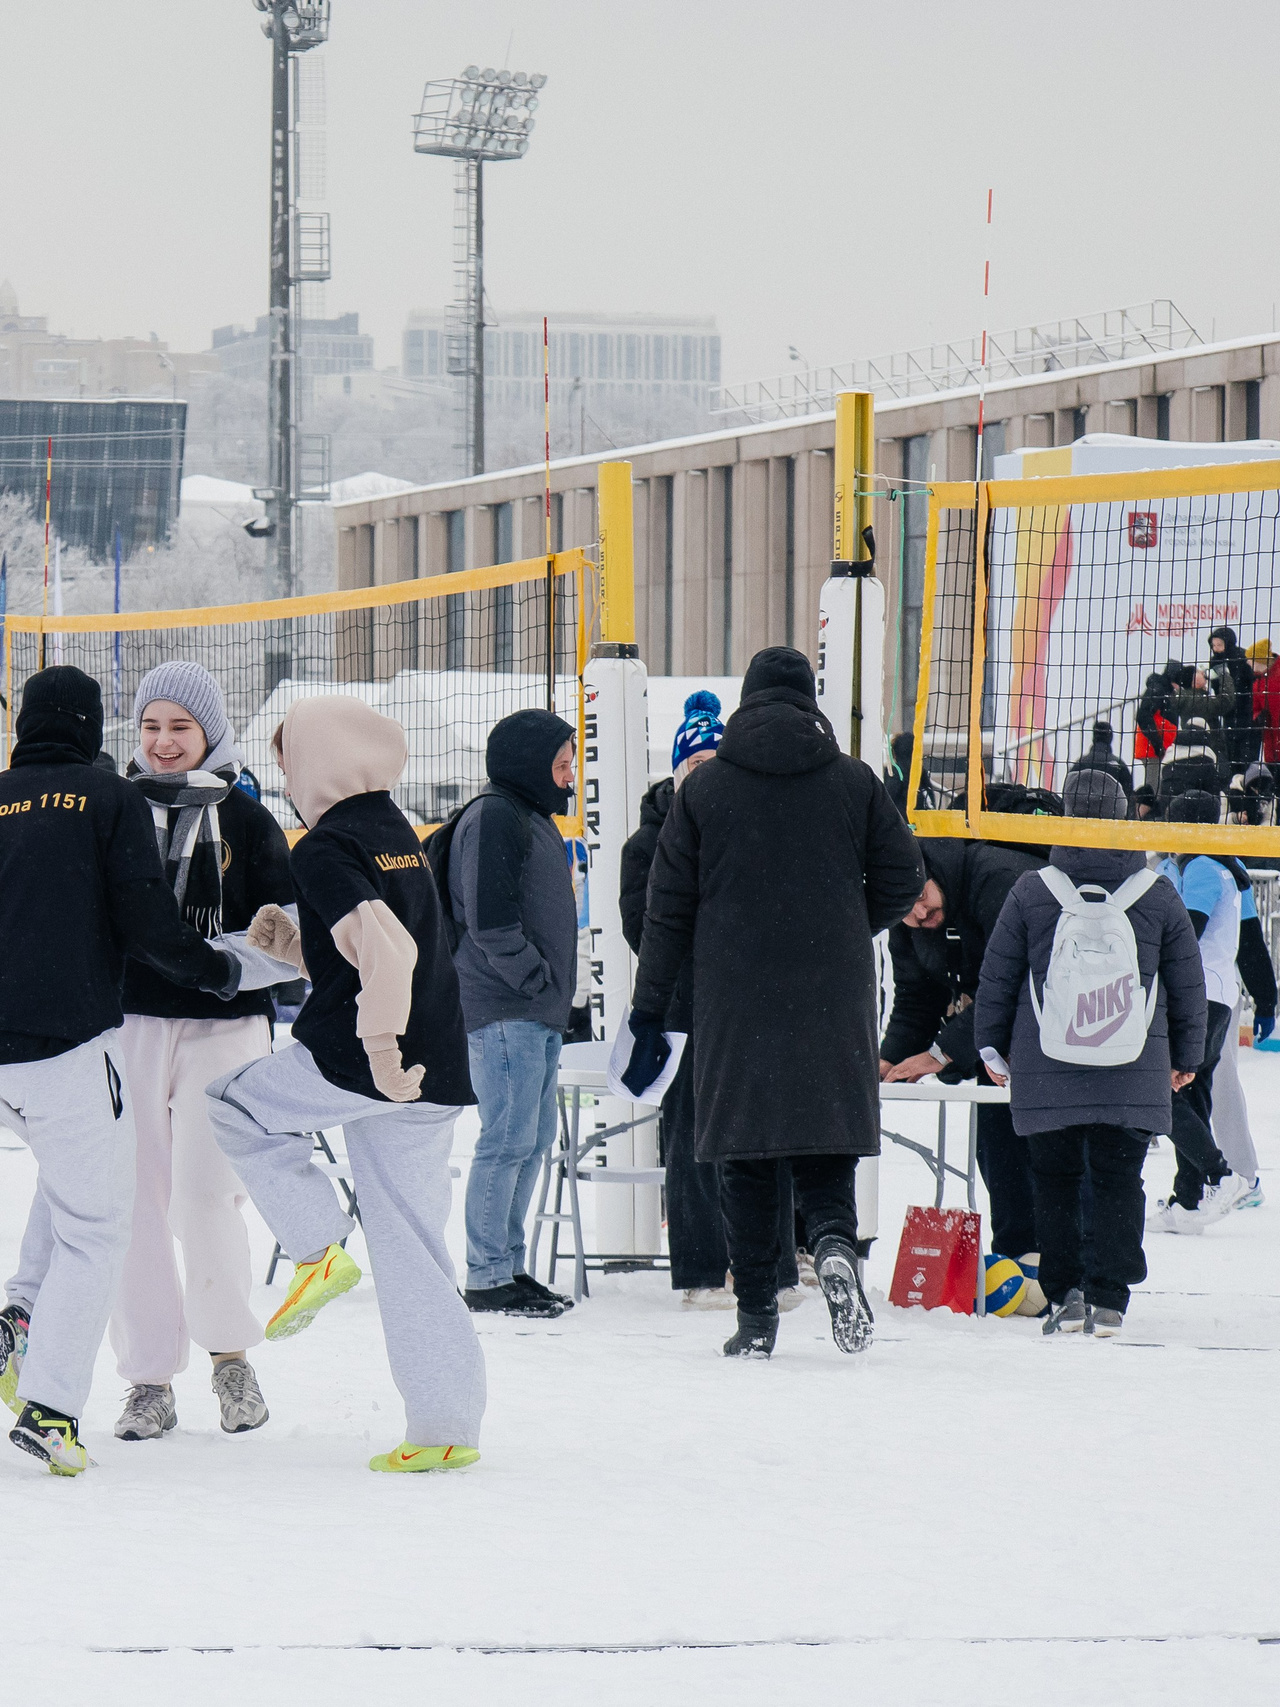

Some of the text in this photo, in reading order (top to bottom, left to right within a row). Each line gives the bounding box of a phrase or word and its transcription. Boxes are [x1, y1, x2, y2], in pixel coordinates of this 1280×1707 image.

[1158, 600, 1238, 619] МОСКОВСКИЙ
[1158, 621, 1195, 637] СПОРТ
[40, 792, 87, 812] 1151
[375, 852, 419, 871] Школа
[1076, 972, 1135, 1028] NIKE
